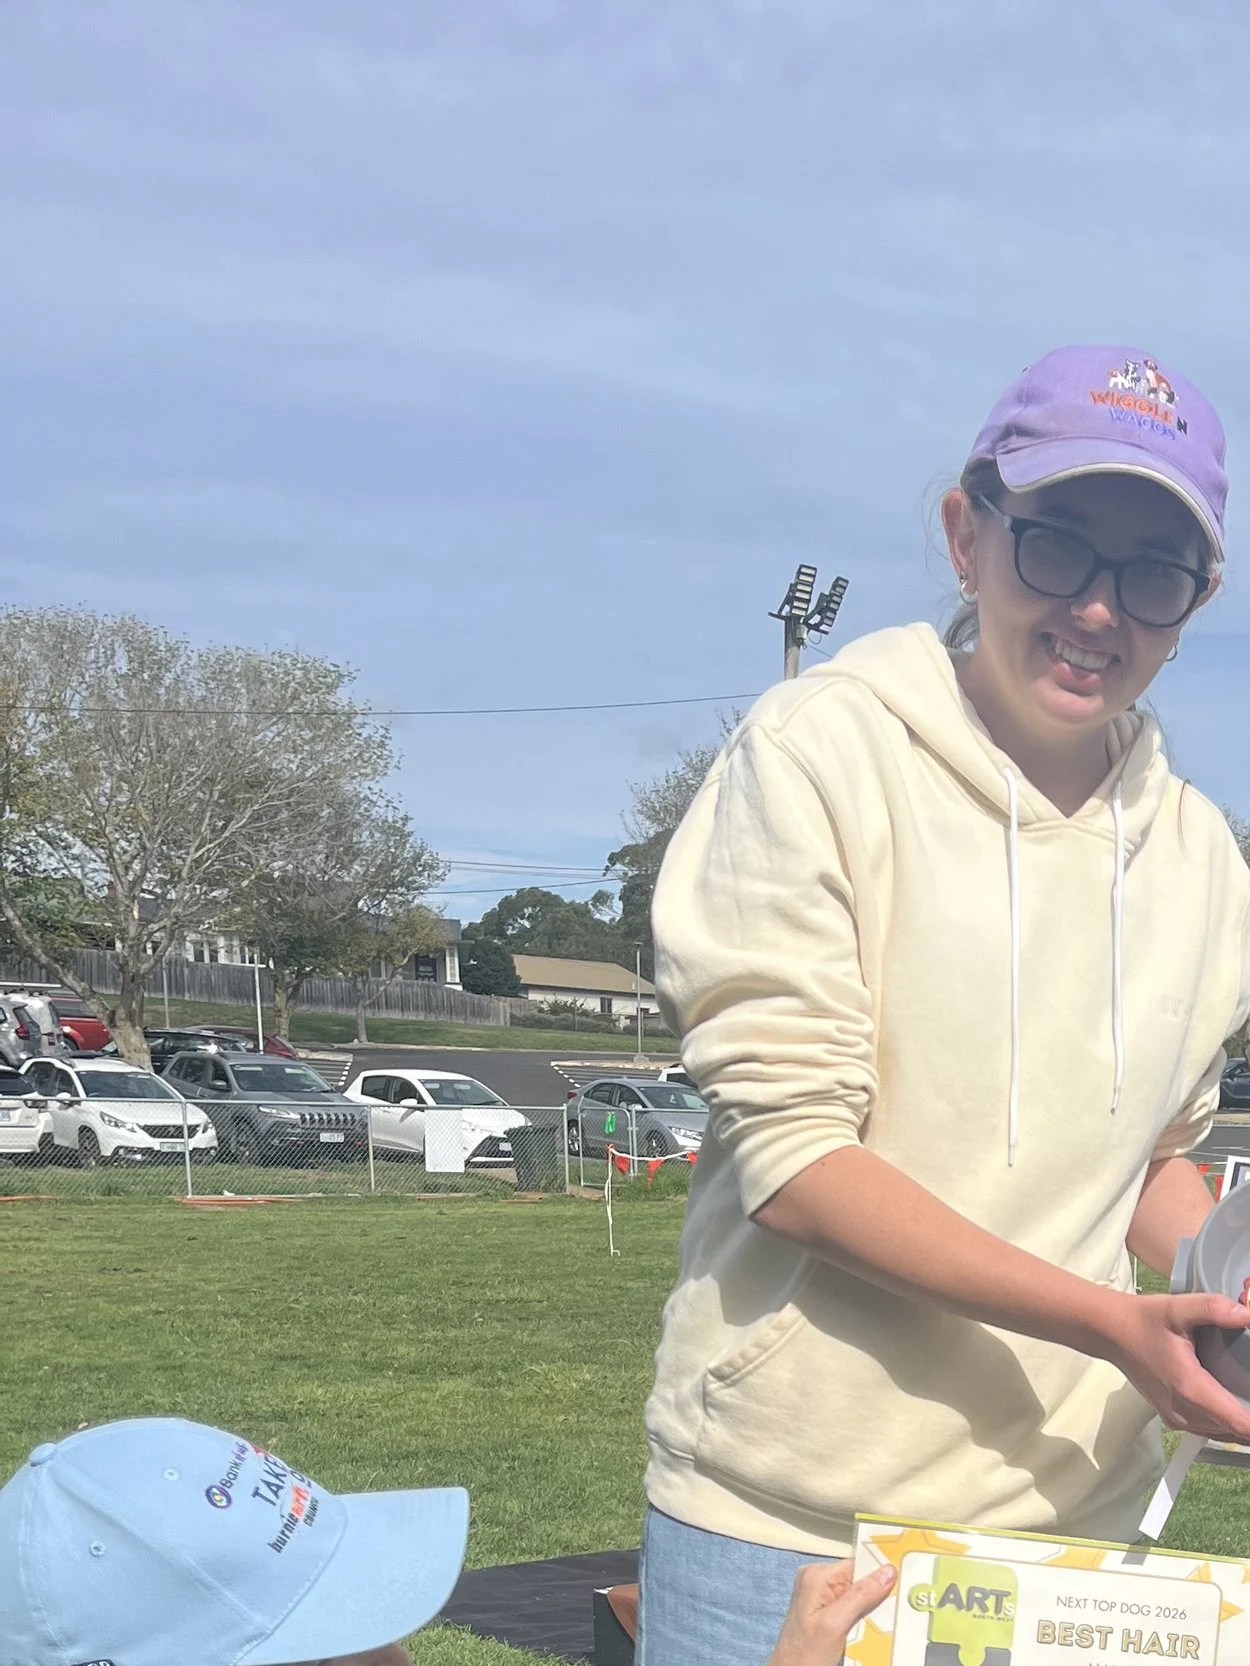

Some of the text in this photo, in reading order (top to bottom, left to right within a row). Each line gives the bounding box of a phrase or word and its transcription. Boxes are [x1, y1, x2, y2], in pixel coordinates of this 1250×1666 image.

[1177, 416, 1188, 435] N
[1056, 1595, 1187, 1620] NEXT TOP DOG 2026
[1036, 1619, 1200, 1660] BEST HAIR
